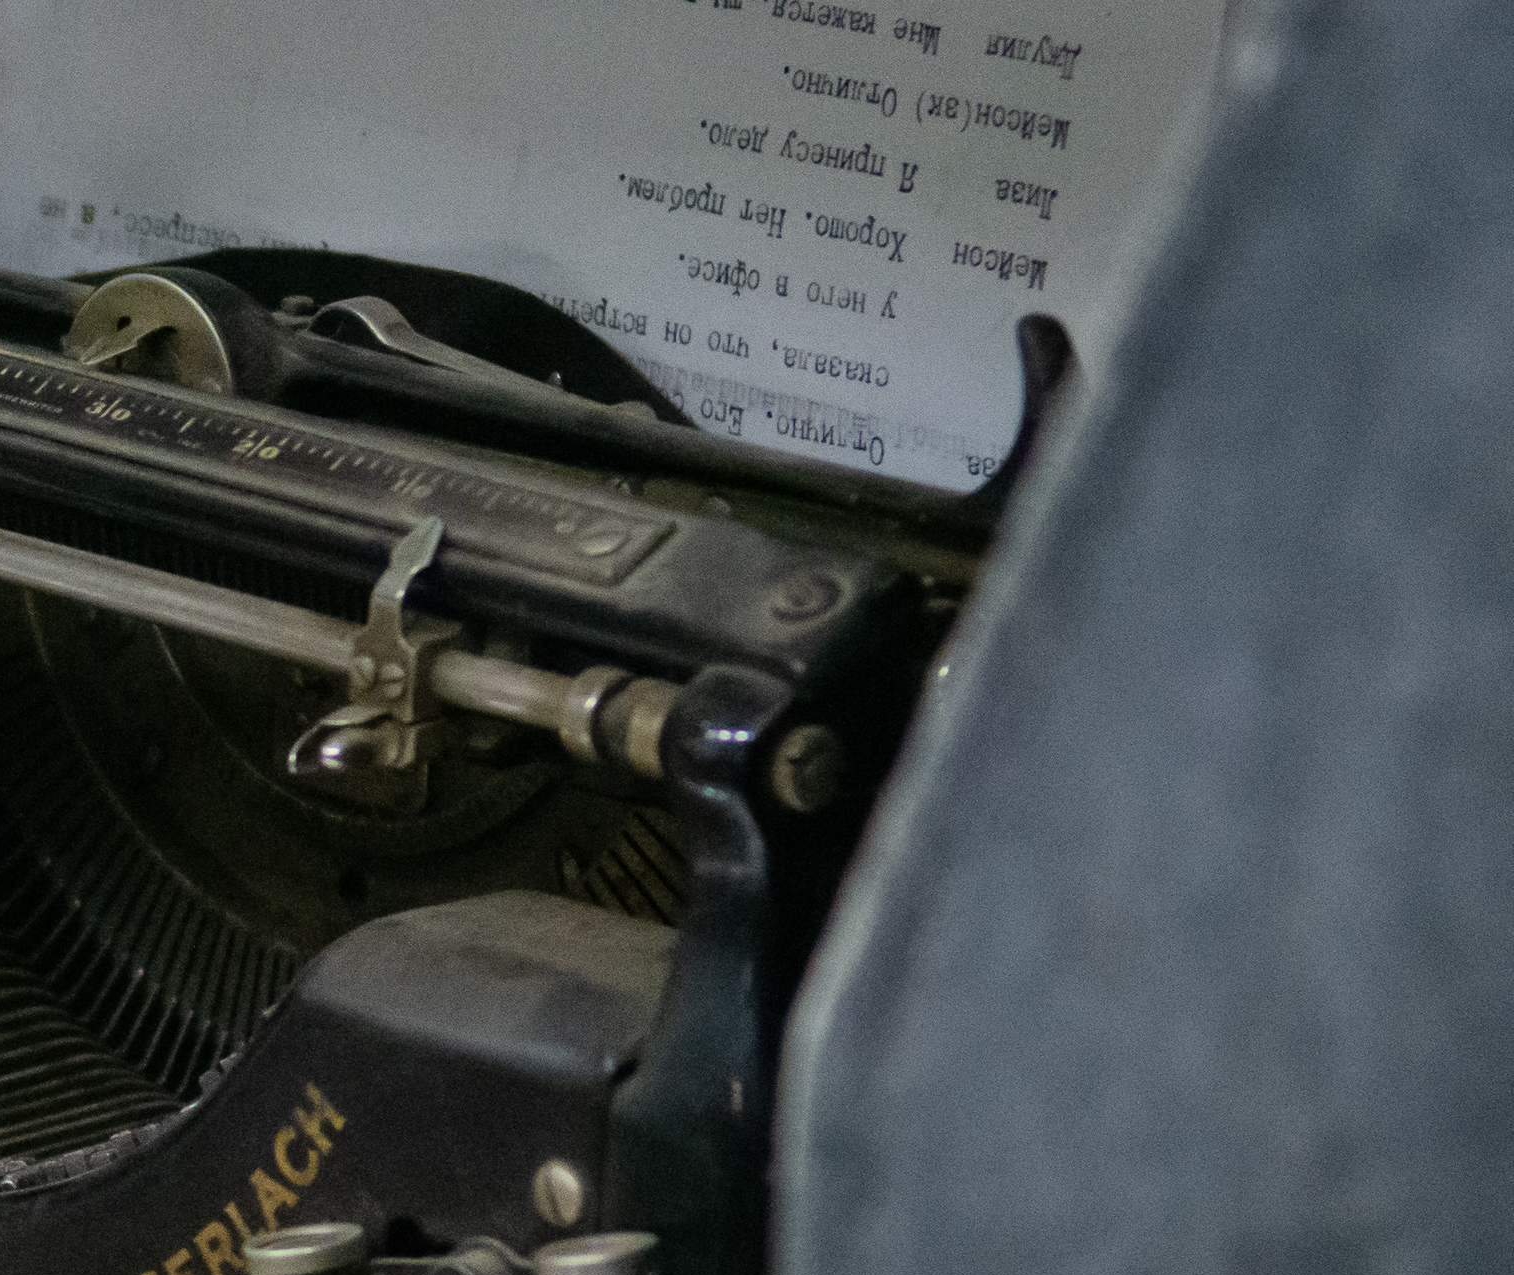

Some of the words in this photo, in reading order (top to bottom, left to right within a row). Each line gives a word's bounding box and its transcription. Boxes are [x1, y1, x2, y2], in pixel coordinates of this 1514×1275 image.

[765, 0, 875, 34] кажется
[894, 18, 941, 56] Мне
[985, 33, 1082, 79] Джулия
[783, 66, 898, 117] Отлично.
[699, 119, 769, 155] дело.
[780, 129, 886, 178] принесу
[618, 173, 726, 215] проблем.
[898, 162, 919, 194] Я
[995, 177, 1059, 220] Лиза
[739, 195, 786, 238] Нет
[678, 253, 761, 297] офисе.
[952, 241, 1049, 290] Мейсон
[775, 276, 790, 298] в
[806, 281, 868, 315] него
[880, 290, 900, 319] у
[541, 295, 648, 337] встрети
[664, 321, 693, 345] он
[709, 328, 751, 359] что
[771, 338, 890, 388] сказала,
[84, 399, 131, 422] 30
[231, 438, 281, 461] 20
[700, 400, 745, 437] Его
[766, 410, 886, 466] Отлично.
